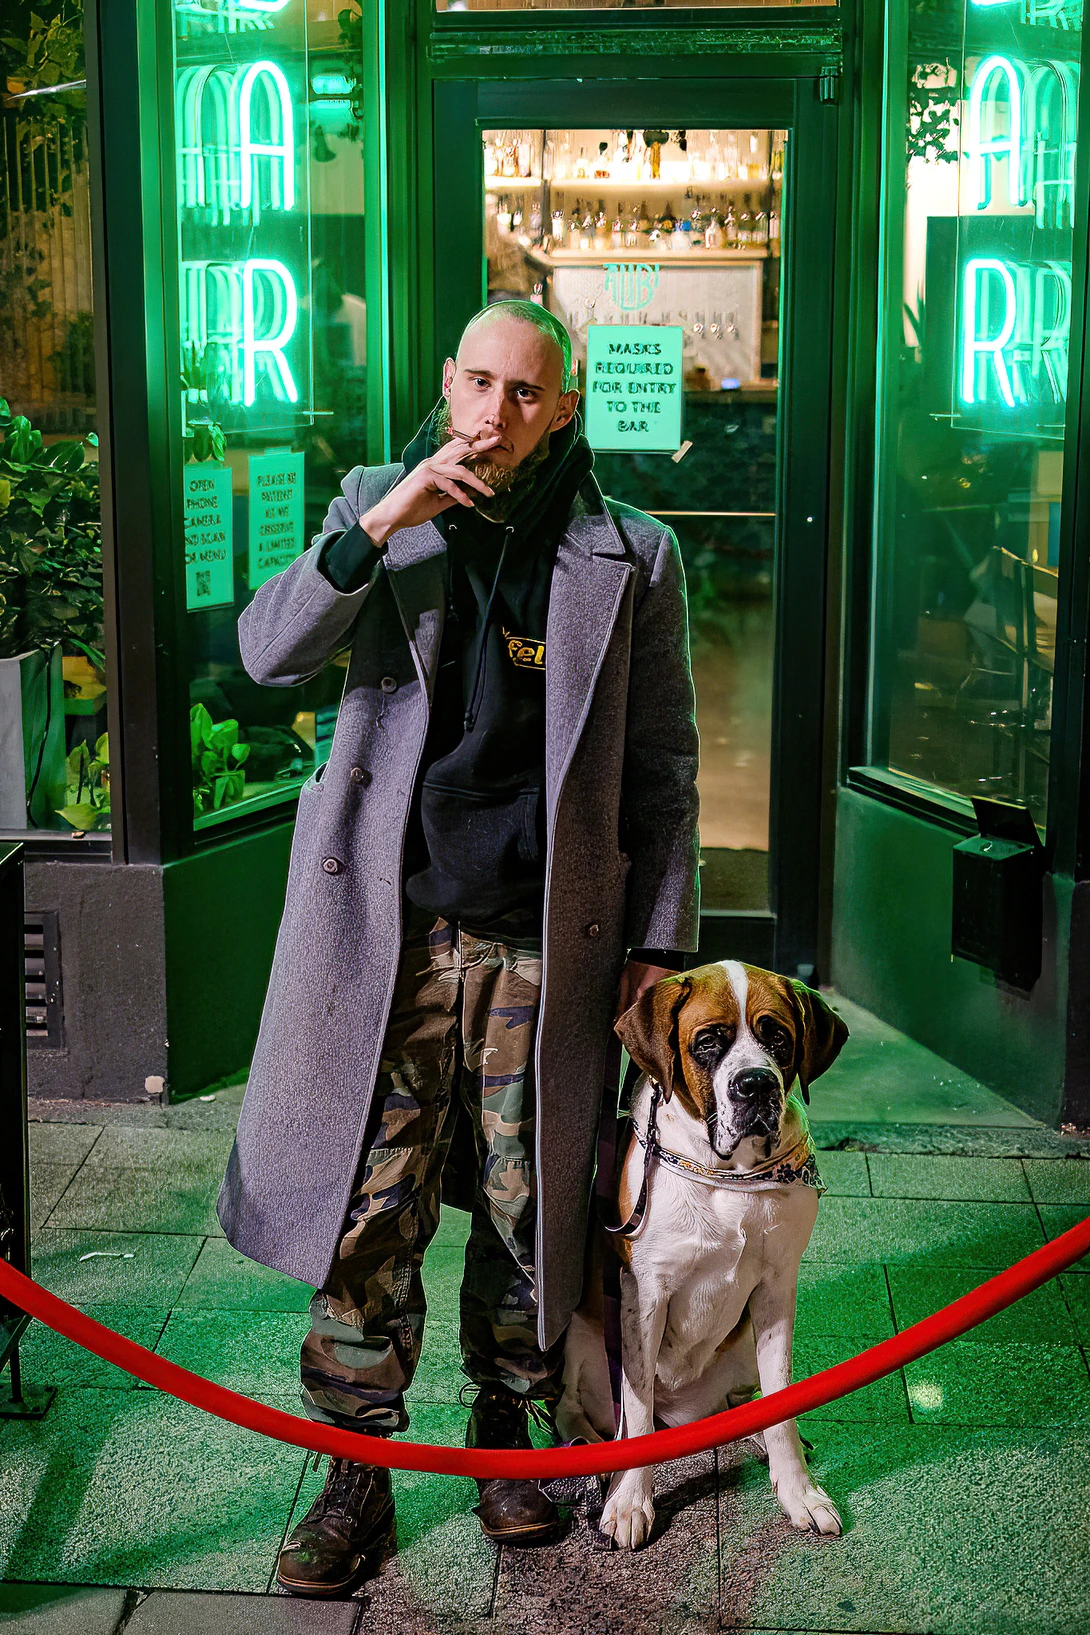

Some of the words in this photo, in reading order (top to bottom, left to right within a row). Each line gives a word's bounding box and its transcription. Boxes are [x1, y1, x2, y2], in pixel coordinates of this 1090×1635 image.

[608, 343, 662, 355] MASKS
[595, 362, 674, 375] REQUIRED
[592, 381, 622, 394] FOR
[628, 381, 677, 394] ENTRY
[607, 400, 627, 413] TO
[631, 401, 661, 414] THE
[617, 420, 649, 432] BAR
[189, 479, 215, 492] OPEN
[186, 495, 219, 510] PHONE
[184, 534, 198, 546] ND
[184, 552, 197, 564] OR
